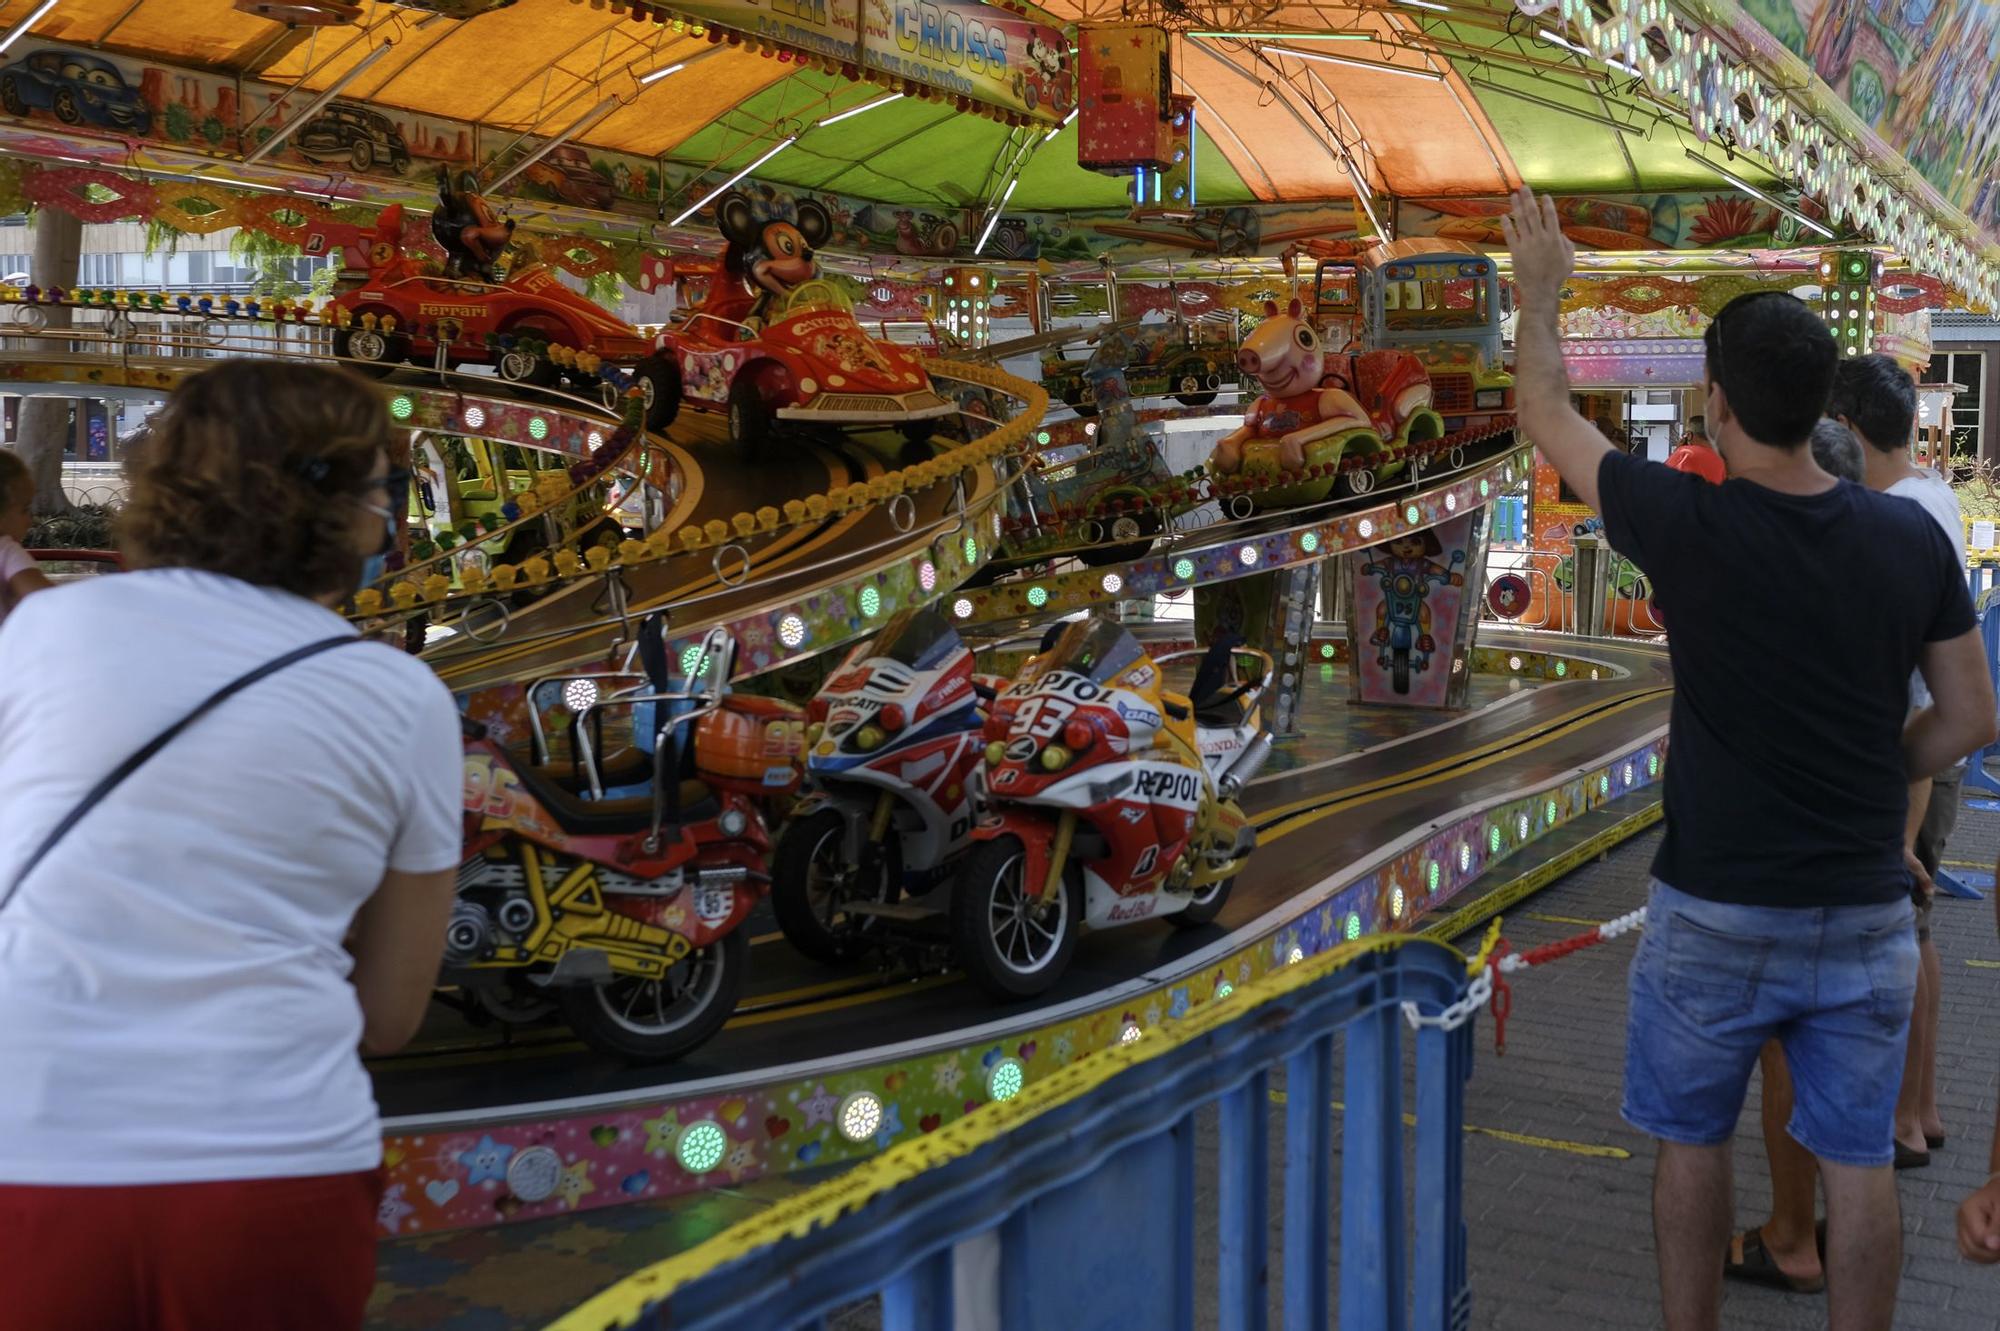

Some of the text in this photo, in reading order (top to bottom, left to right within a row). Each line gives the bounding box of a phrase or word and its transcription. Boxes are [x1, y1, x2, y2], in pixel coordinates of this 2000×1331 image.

[758, 15, 781, 38] LA
[904, 60, 929, 80] LOS
[895, 0, 1007, 81] CROSS
[1415, 264, 1458, 279] BUS
[419, 302, 488, 318] Ferrari
[1009, 699, 1076, 738] 93
[764, 720, 804, 757] 95
[464, 761, 519, 818] 95
[1133, 769, 1198, 802] REPSOL
